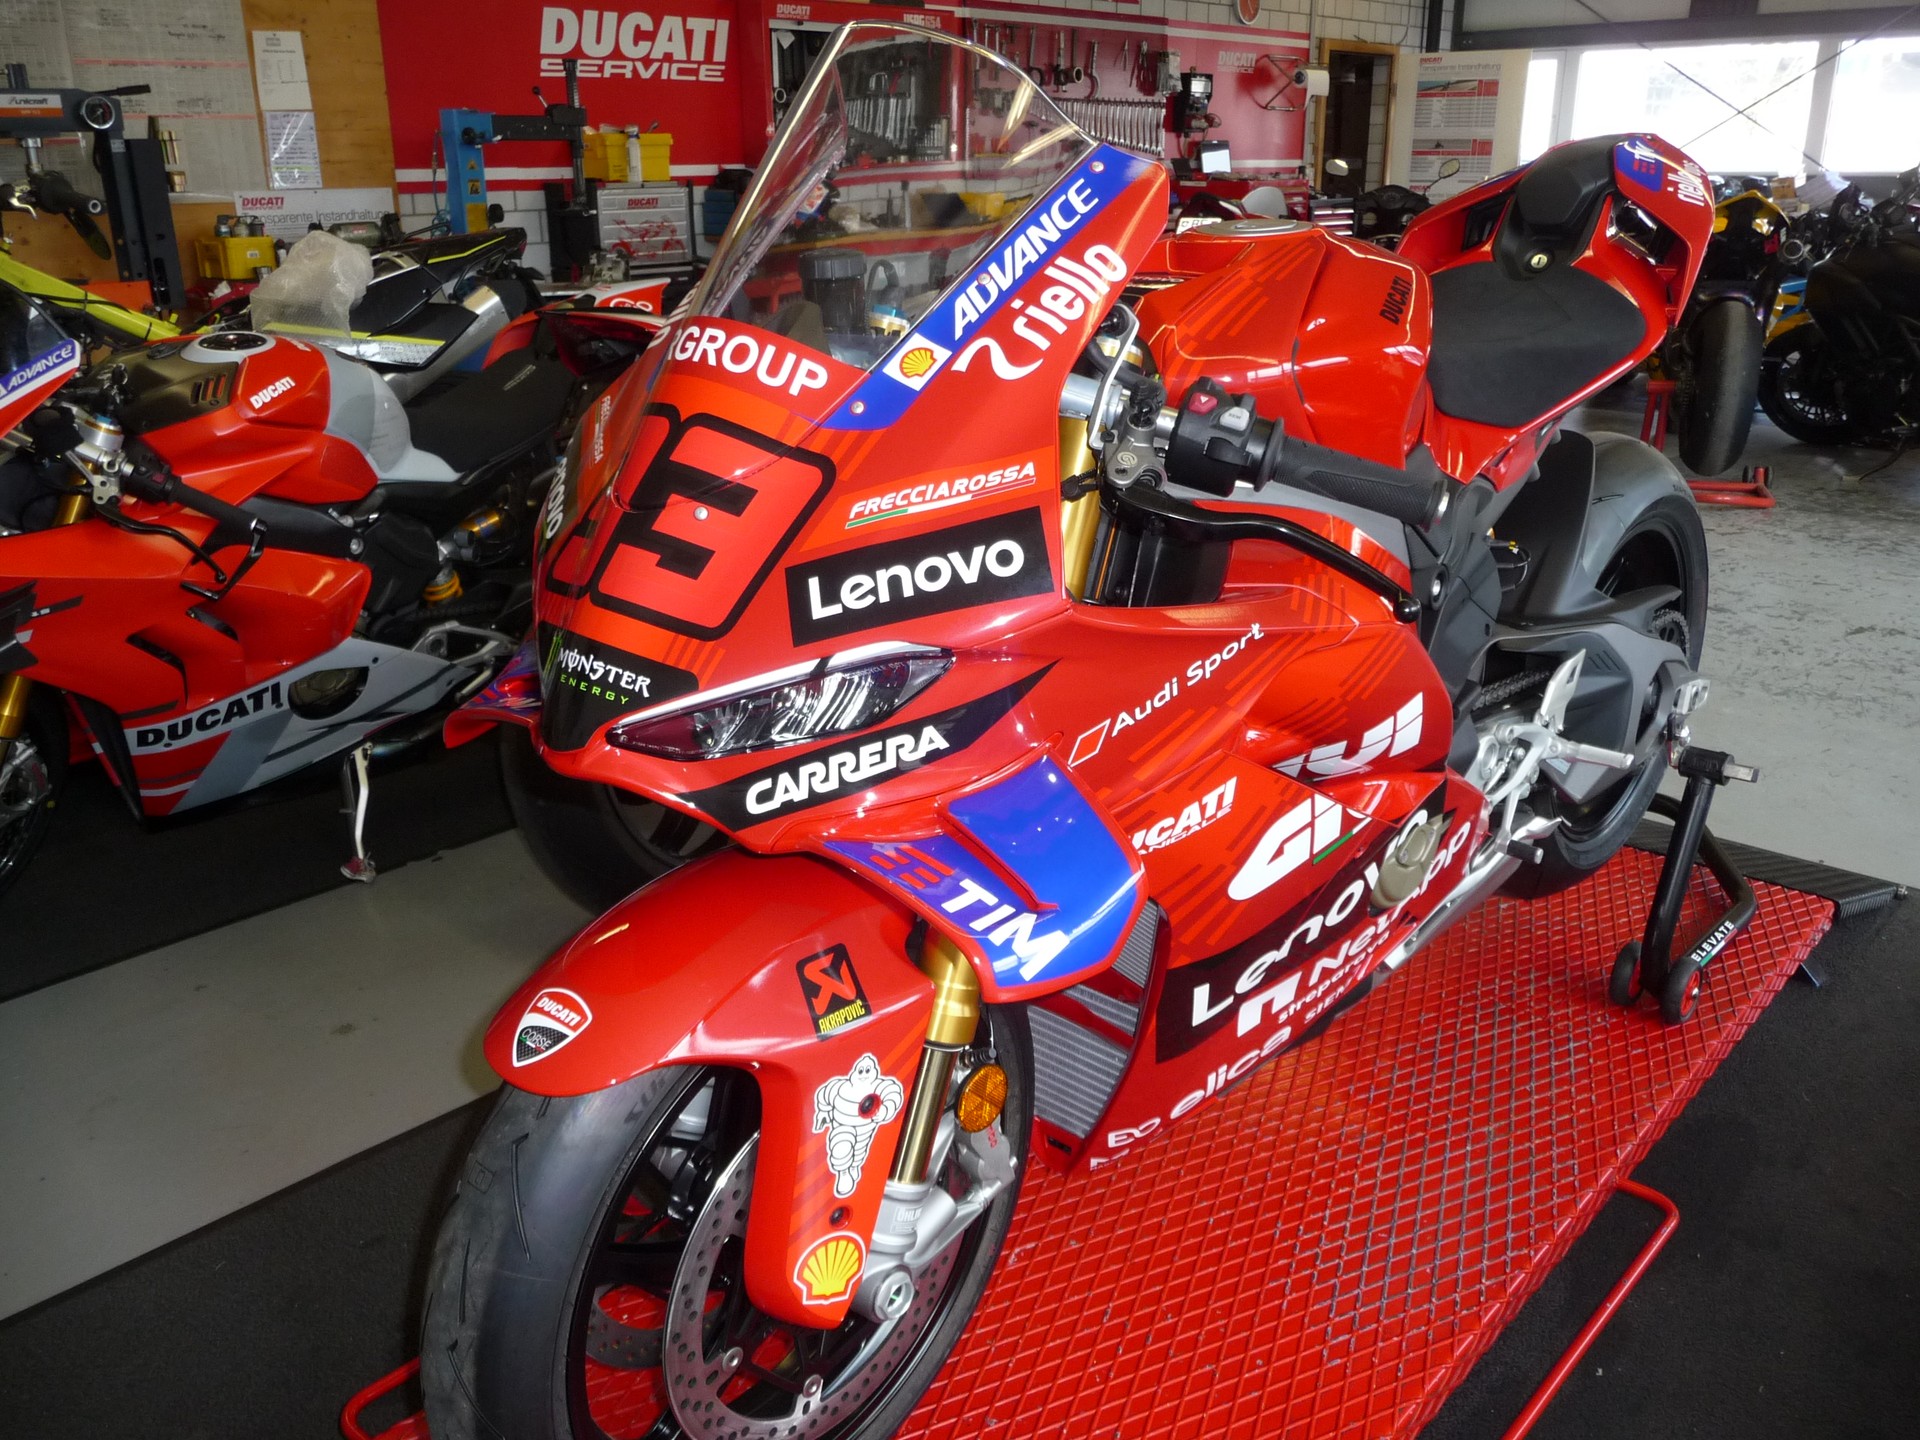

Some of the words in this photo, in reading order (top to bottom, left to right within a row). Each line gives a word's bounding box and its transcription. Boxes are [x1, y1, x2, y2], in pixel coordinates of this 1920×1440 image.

[776, 3, 811, 14] DUCATI
[540, 7, 730, 62] DUCATI
[1218, 51, 1256, 67] DUCATI
[540, 58, 726, 82] SERVICE
[241, 196, 285, 207] DUCATI
[242, 212, 314, 225] Tnsparente
[627, 198, 659, 207] DUCATI
[954, 178, 1100, 341] ADVANCE
[1010, 244, 1128, 351] riello
[1380, 276, 1412, 325] DUCATI
[8, 344, 73, 391] ADVANCE
[674, 326, 828, 397] GROUP
[250, 376, 296, 410] DUCATI
[849, 462, 1036, 519] FRECCIAROSSA
[807, 540, 1026, 621] Lenovo
[557, 648, 651, 698] MONSTER
[560, 674, 629, 705] ENERGY
[1111, 677, 1179, 738] Audi
[1186, 622, 1265, 687] Sport
[136, 682, 282, 748] DUCATI
[745, 725, 950, 815] CARRERA
[1137, 803, 1235, 856] ANIGALE
[941, 878, 1070, 982] TIM
[1690, 920, 1735, 962] ELEVATE
[1278, 930, 1390, 1024] streparava
[536, 997, 582, 1027] DUCATI
[521, 1028, 552, 1051] CORSE
[1170, 1026, 1292, 1120] elica
